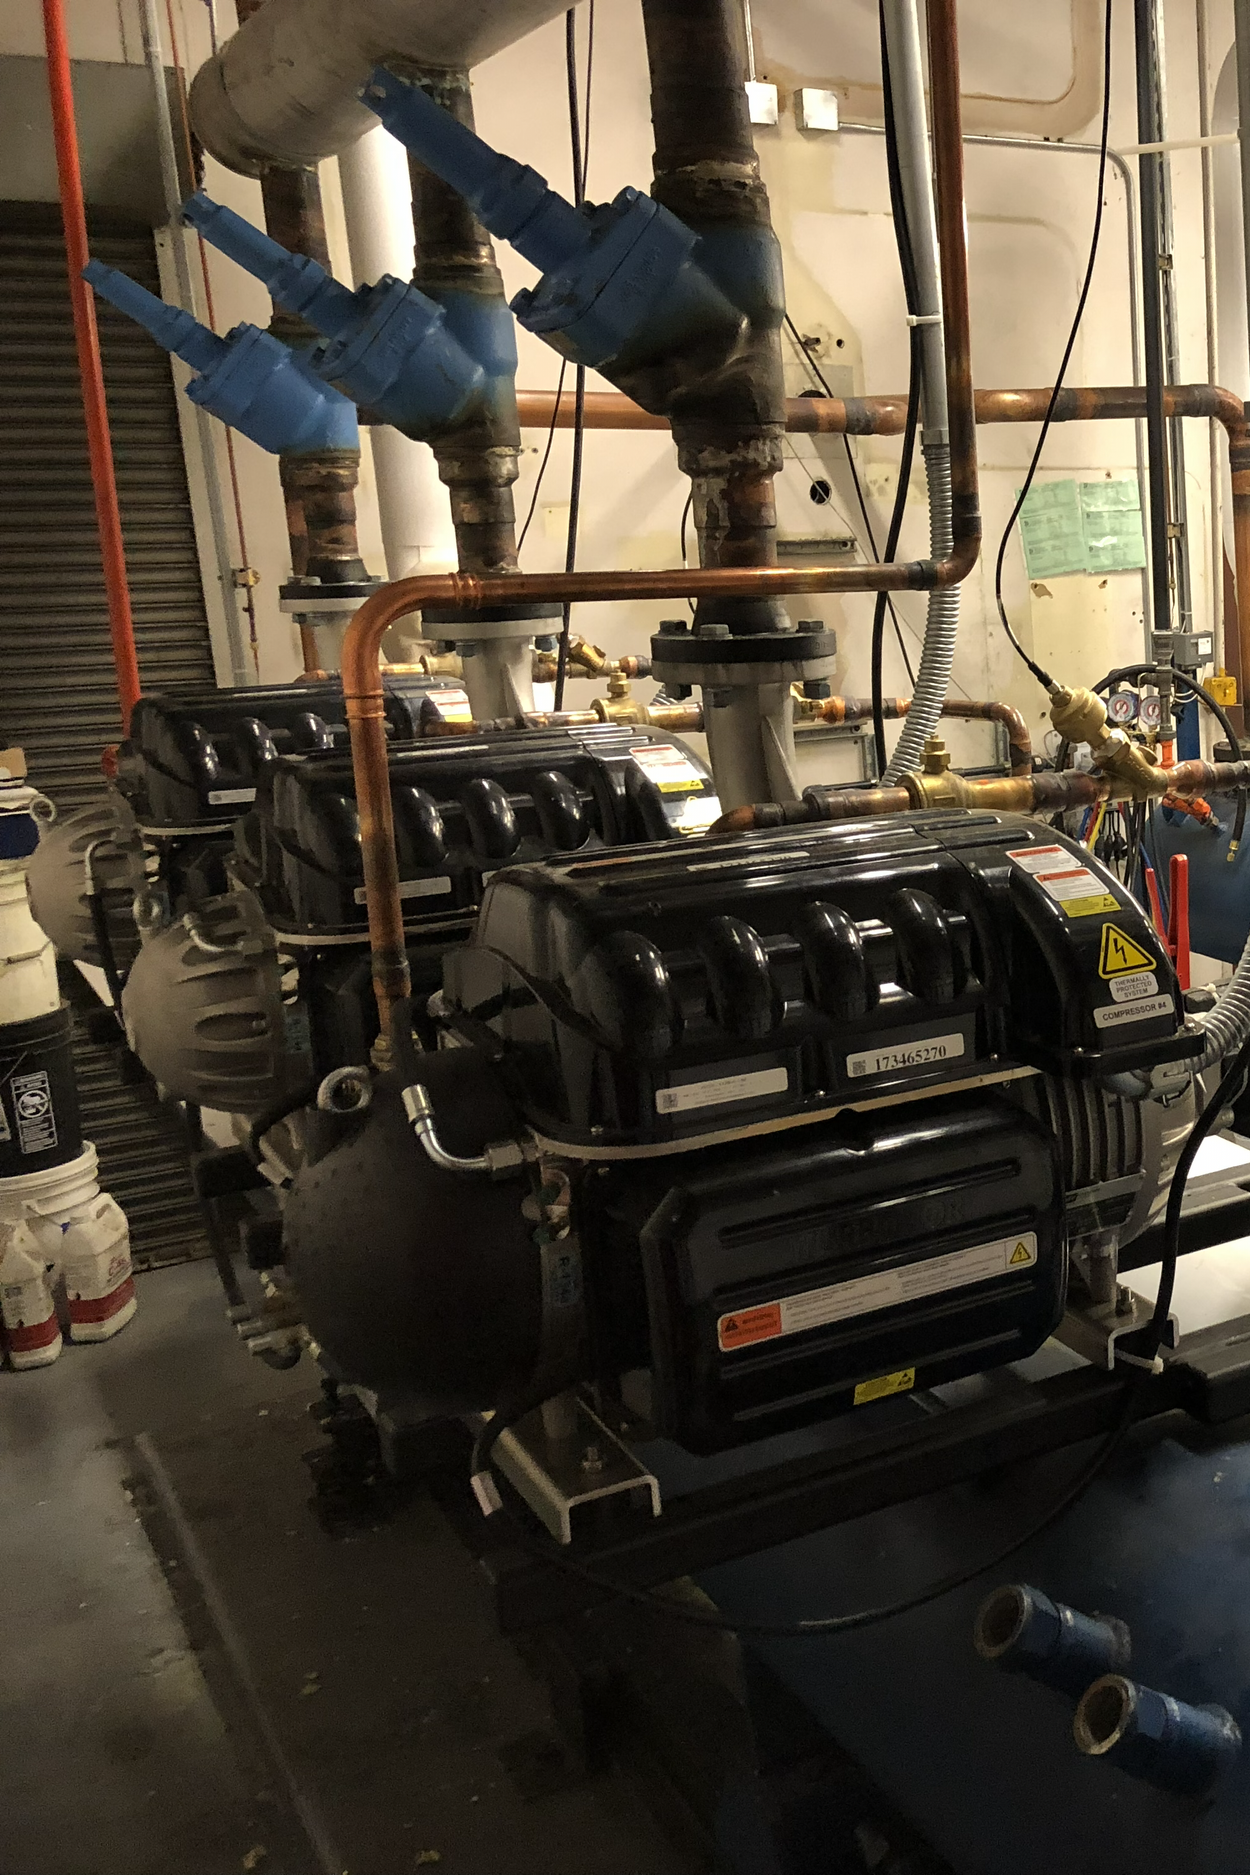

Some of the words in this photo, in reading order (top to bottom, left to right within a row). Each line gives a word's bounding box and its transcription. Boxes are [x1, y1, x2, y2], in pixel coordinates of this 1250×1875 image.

[1114, 975, 1150, 987] THERMALLY
[1116, 981, 1152, 993] PROTECTED
[1124, 988, 1148, 998] SYSTEM
[1102, 1003, 1157, 1020] COMPRESSOR
[1158, 1001, 1167, 1009] #4
[875, 1045, 947, 1071] 173465270
